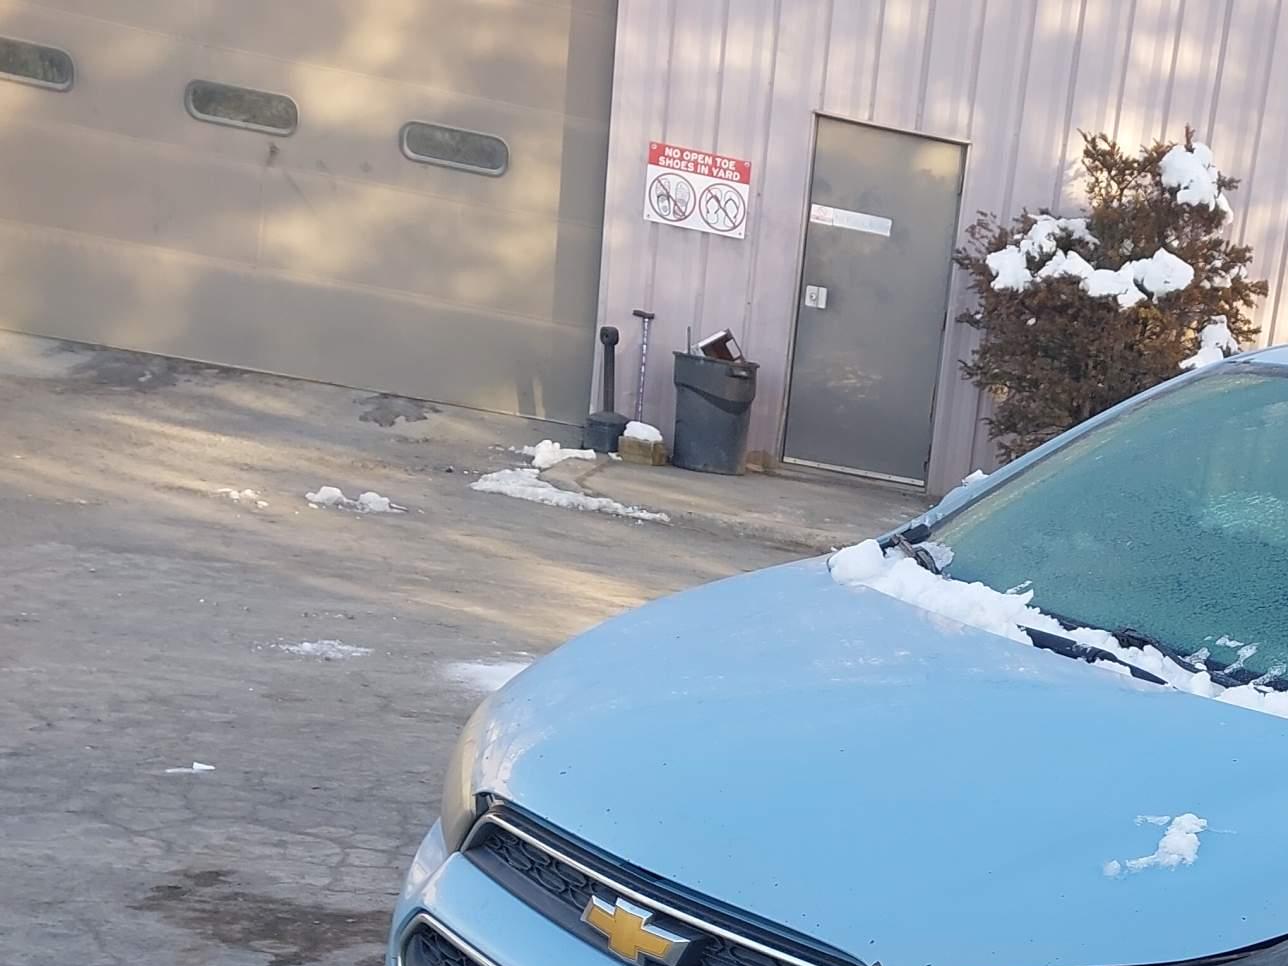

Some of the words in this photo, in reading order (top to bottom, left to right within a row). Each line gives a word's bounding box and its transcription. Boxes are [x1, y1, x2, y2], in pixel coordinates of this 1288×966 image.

[658, 156, 694, 171] SHOES
[697, 164, 709, 174] IN
[712, 167, 740, 181] YARD
[664, 147, 681, 158] NO
[683, 151, 712, 165] OPEN
[715, 157, 736, 170] TOE
